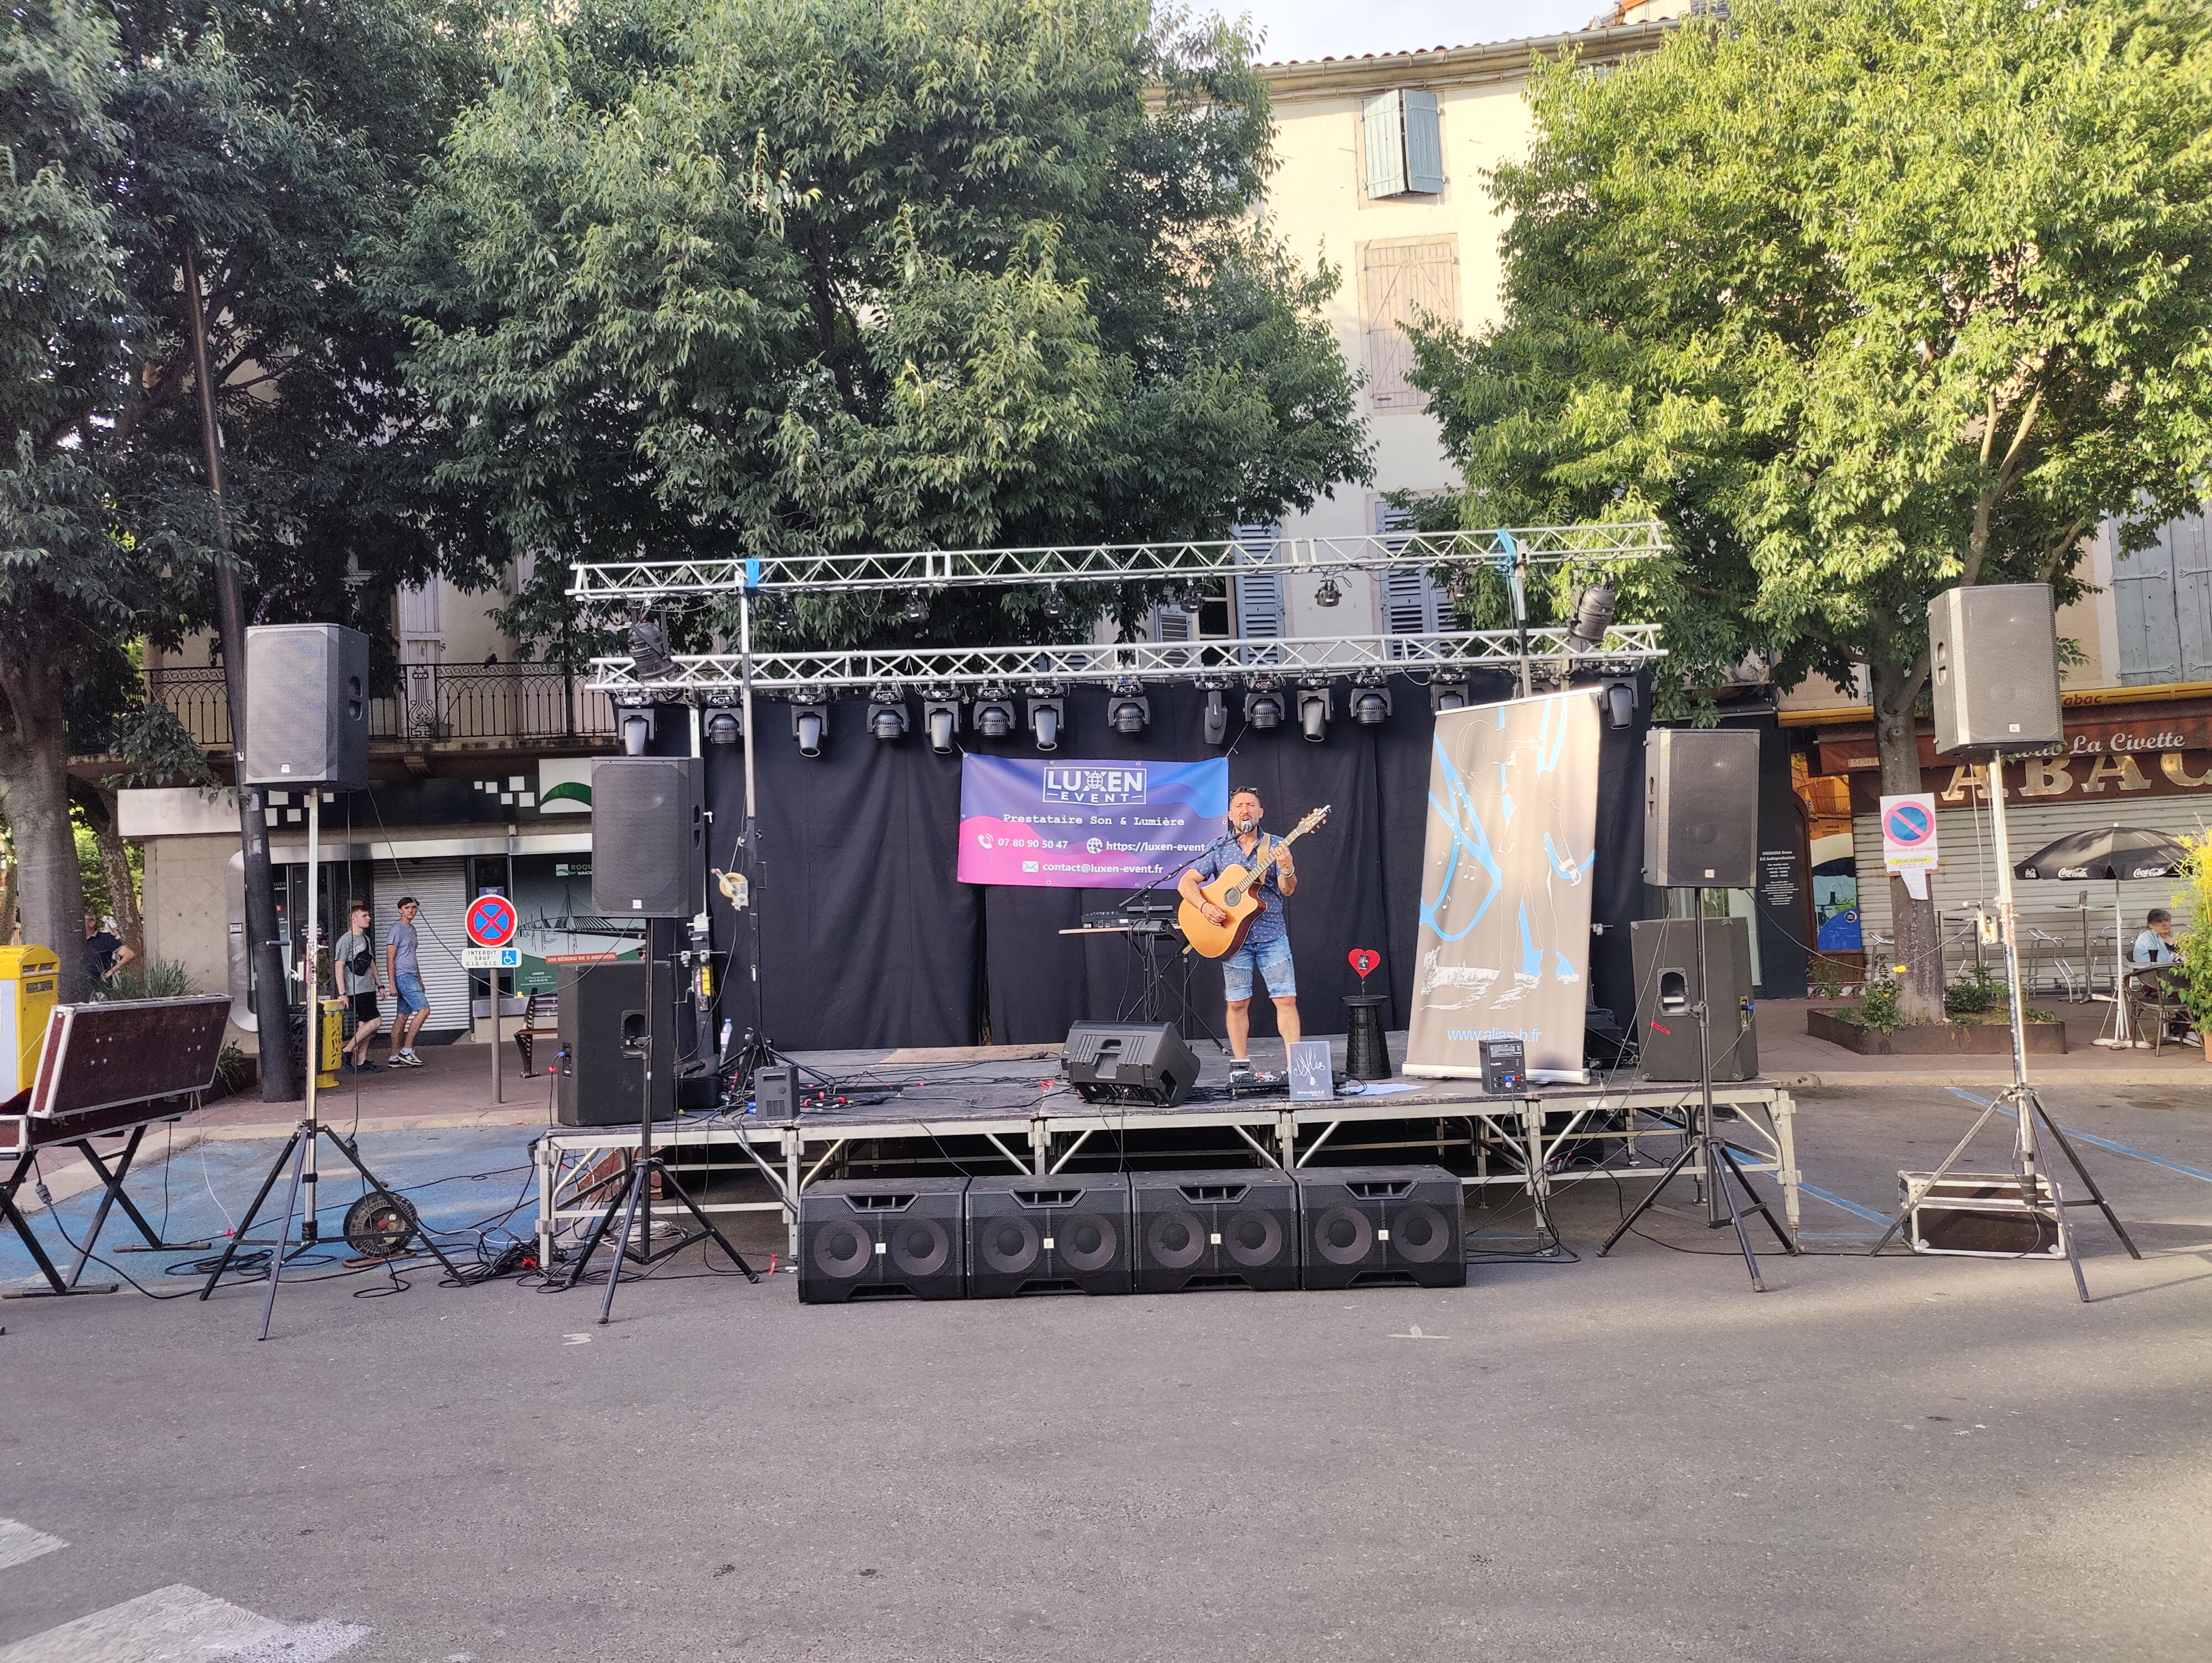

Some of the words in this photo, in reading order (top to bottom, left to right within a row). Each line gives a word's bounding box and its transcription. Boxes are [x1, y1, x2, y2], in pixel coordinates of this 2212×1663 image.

[2060, 693, 2103, 707] abac
[2069, 735, 2103, 754] La
[2110, 732, 2185, 751] Civette
[1850, 758, 1871, 767] Midi
[1047, 770, 1142, 792] LUXEN
[1061, 791, 1129, 803] EVENT
[1003, 814, 1083, 824] Prestataire
[1090, 816, 1113, 825] Son
[1120, 817, 1127, 825] &
[1134, 817, 1185, 826] Lumière
[998, 838, 1010, 846] 07
[1013, 839, 1025, 848] 80
[1027, 839, 1040, 848] 90
[1041, 840, 1054, 849] 50
[1056, 841, 1068, 849] 47
[1106, 841, 1206, 852] https://luxen-event
[1042, 864, 1164, 874] contact@luxen-event.fr
[2058, 867, 2088, 878] Coca-Cola
[2133, 867, 2166, 878] Coca-Cola
[1447, 1027, 1542, 1043] www.alias-b.fr
